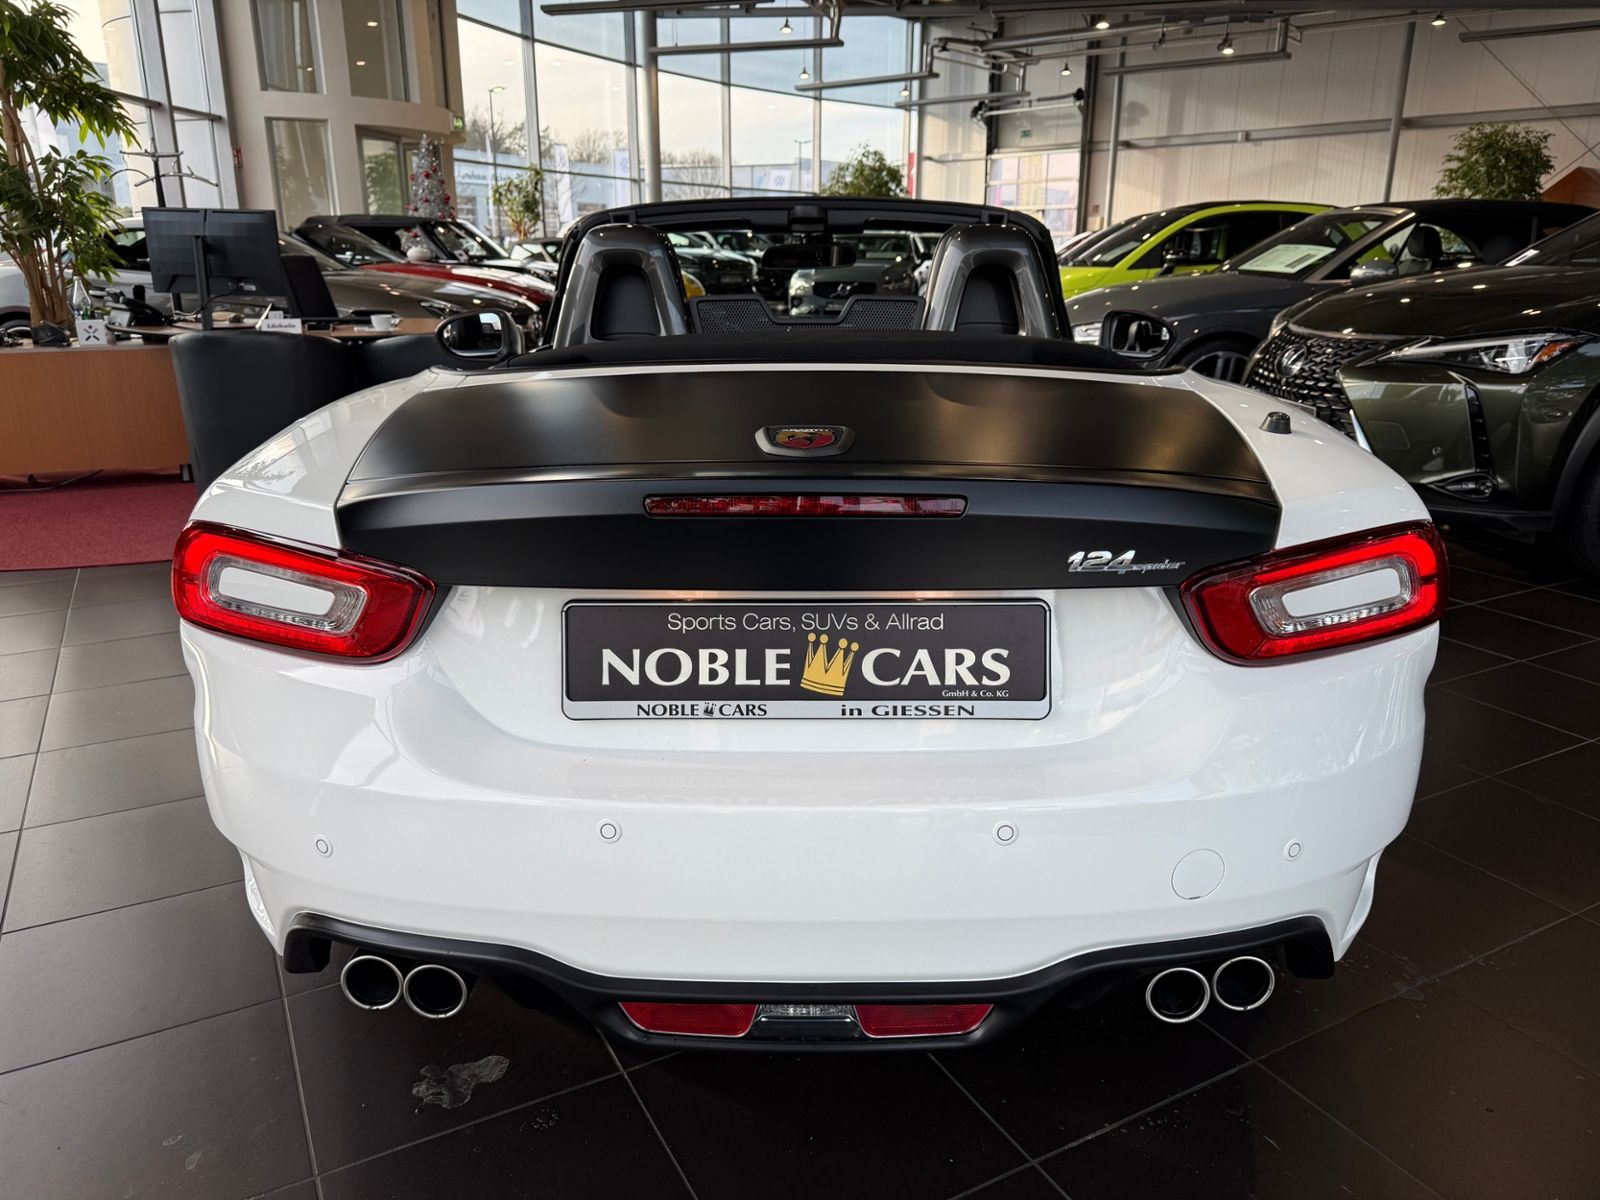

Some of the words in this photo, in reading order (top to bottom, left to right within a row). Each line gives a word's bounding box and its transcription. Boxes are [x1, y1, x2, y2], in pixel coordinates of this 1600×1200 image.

[1068, 550, 1136, 574] 124
[667, 612, 737, 634] Sports
[742, 612, 796, 633] Cars,
[801, 612, 859, 631] SUVs
[864, 612, 881, 631] &
[885, 612, 944, 631] Allrad
[601, 647, 792, 686] NOBLE
[861, 647, 1011, 686] CARS
[941, 689, 969, 698] GmbH
[970, 689, 978, 698] &
[979, 689, 994, 698] Co.
[996, 689, 1009, 698] KG
[636, 703, 700, 717] NOBLE
[718, 703, 768, 717] CARS
[841, 703, 863, 717] in
[871, 704, 975, 717] GIESSEN
